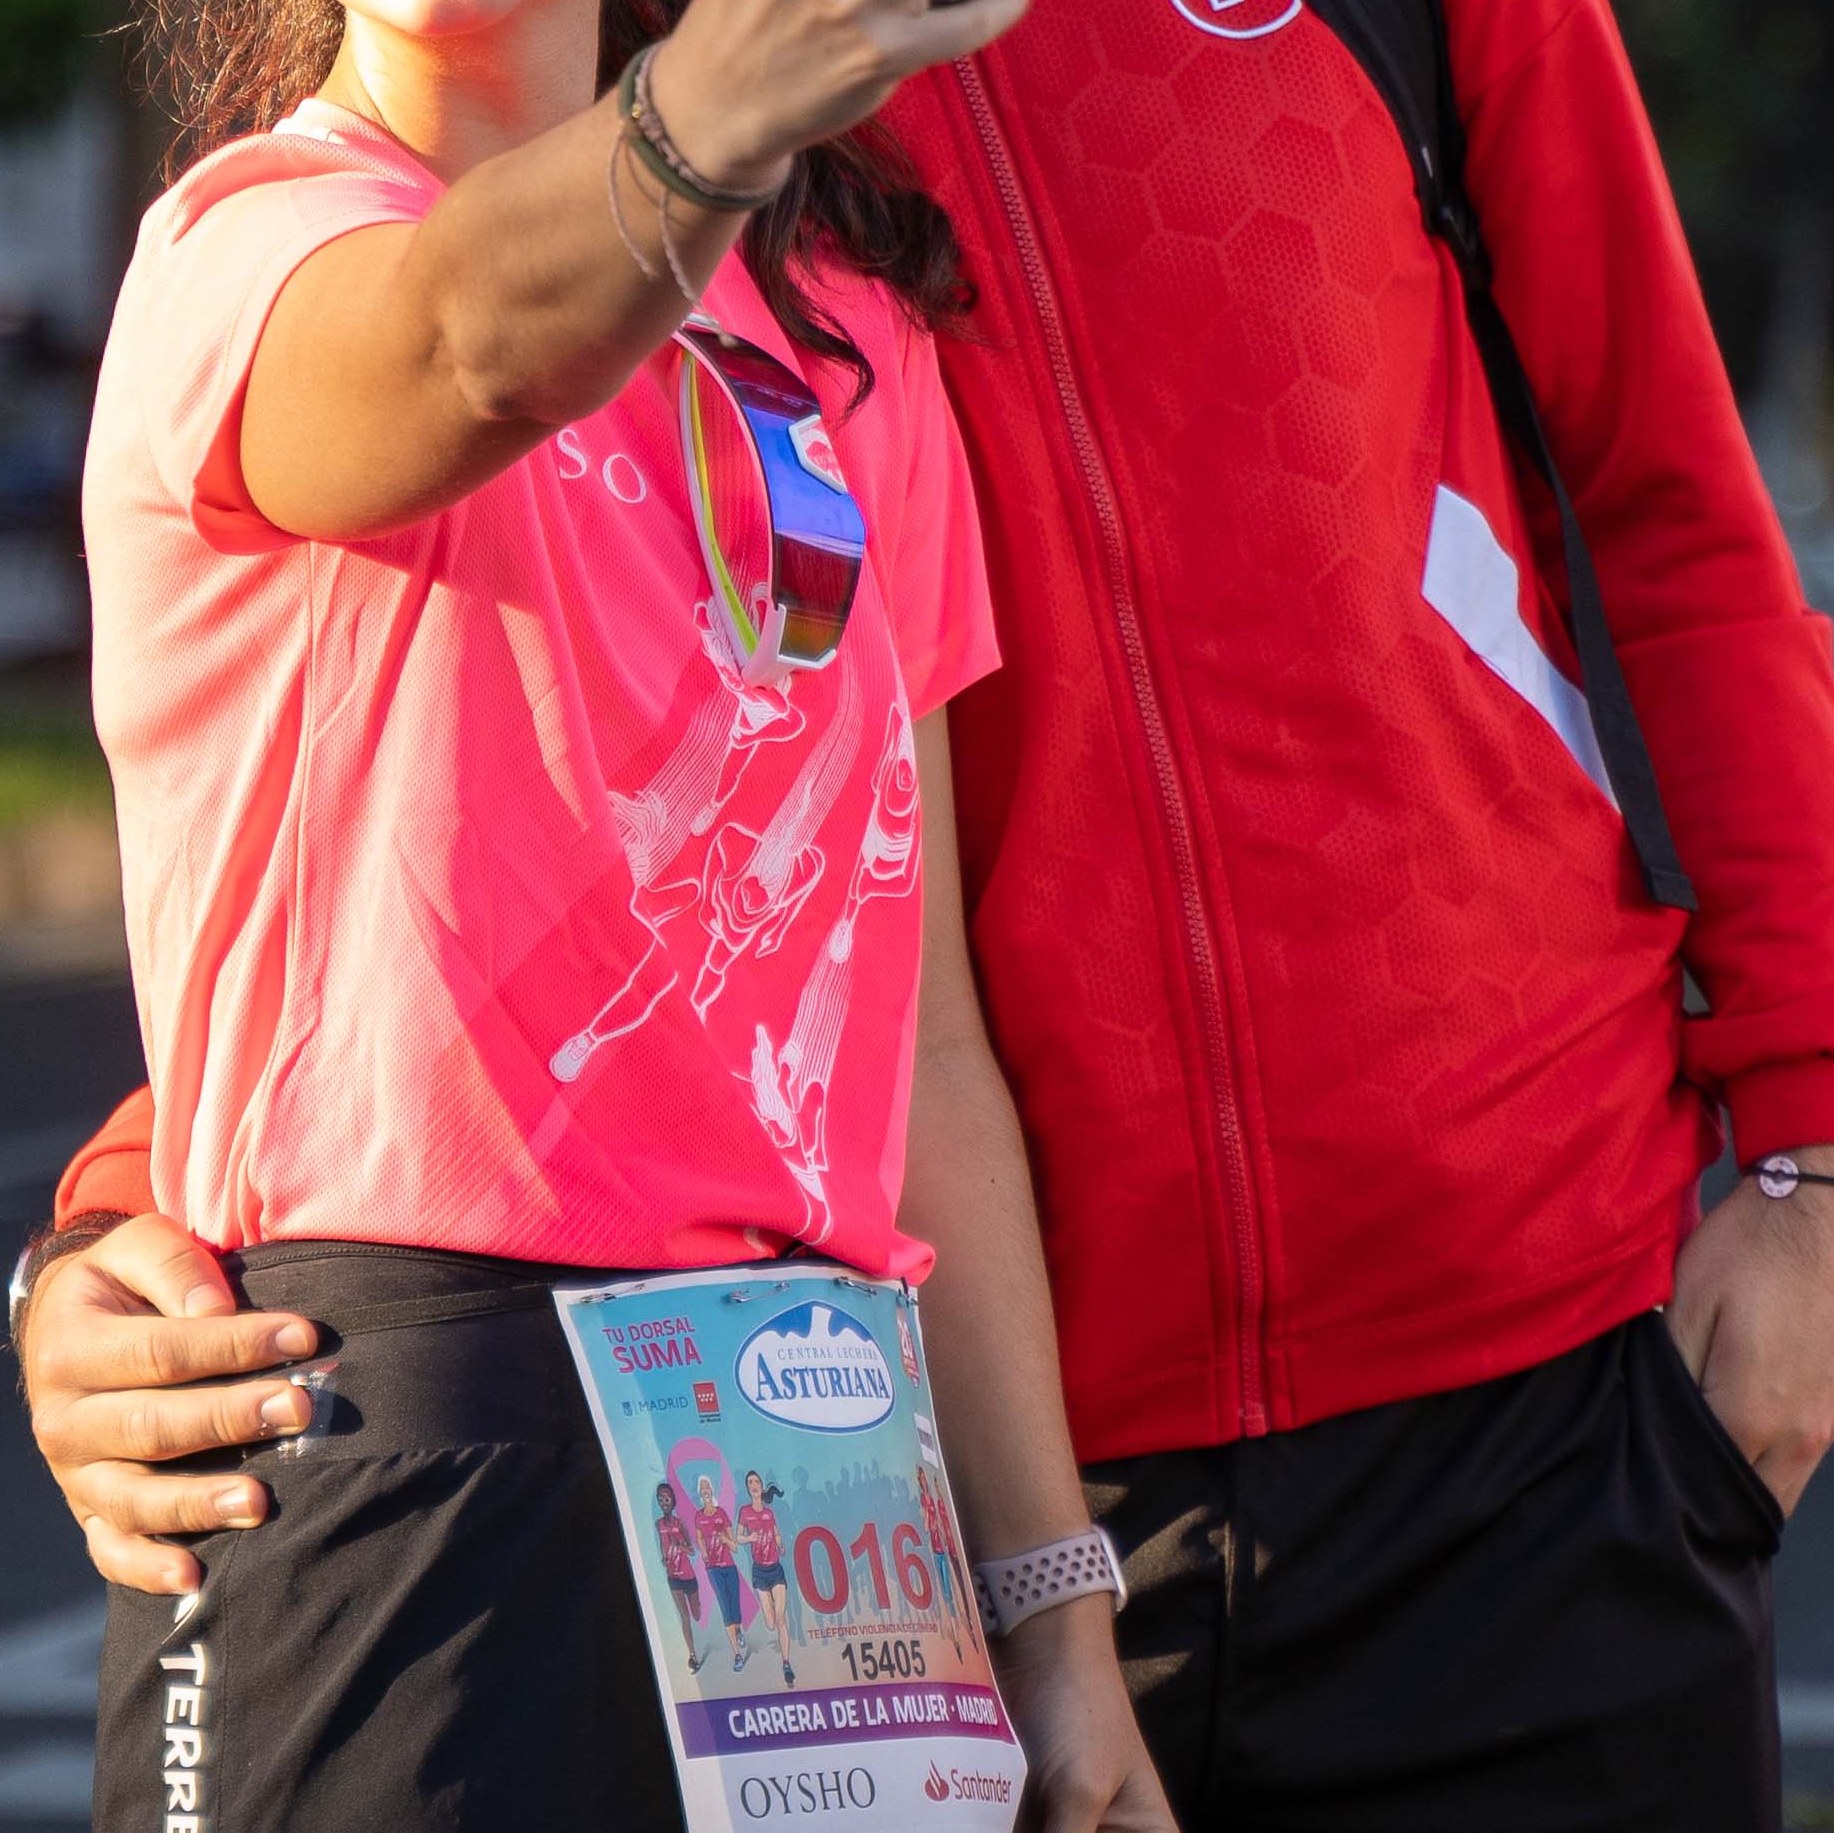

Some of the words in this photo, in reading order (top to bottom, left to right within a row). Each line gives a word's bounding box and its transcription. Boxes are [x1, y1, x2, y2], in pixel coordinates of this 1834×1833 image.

[602, 1327, 625, 1343] TU
[628, 1316, 695, 1342] DORSAL
[612, 1337, 702, 1374] SUMA
[777, 1347, 833, 1360] CENTRAL
[639, 1397, 689, 1412] MADRID
[794, 1523, 933, 1614] 016
[841, 1640, 926, 1681] 15405
[728, 1703, 827, 1739] CARRERA
[830, 1697, 860, 1730] DE
[863, 1696, 890, 1726] LA
[893, 1694, 950, 1723] MUJER
[957, 1695, 998, 1726] MADRID
[740, 1767, 876, 1819] OYSHO
[950, 1769, 1012, 1804] Santander
